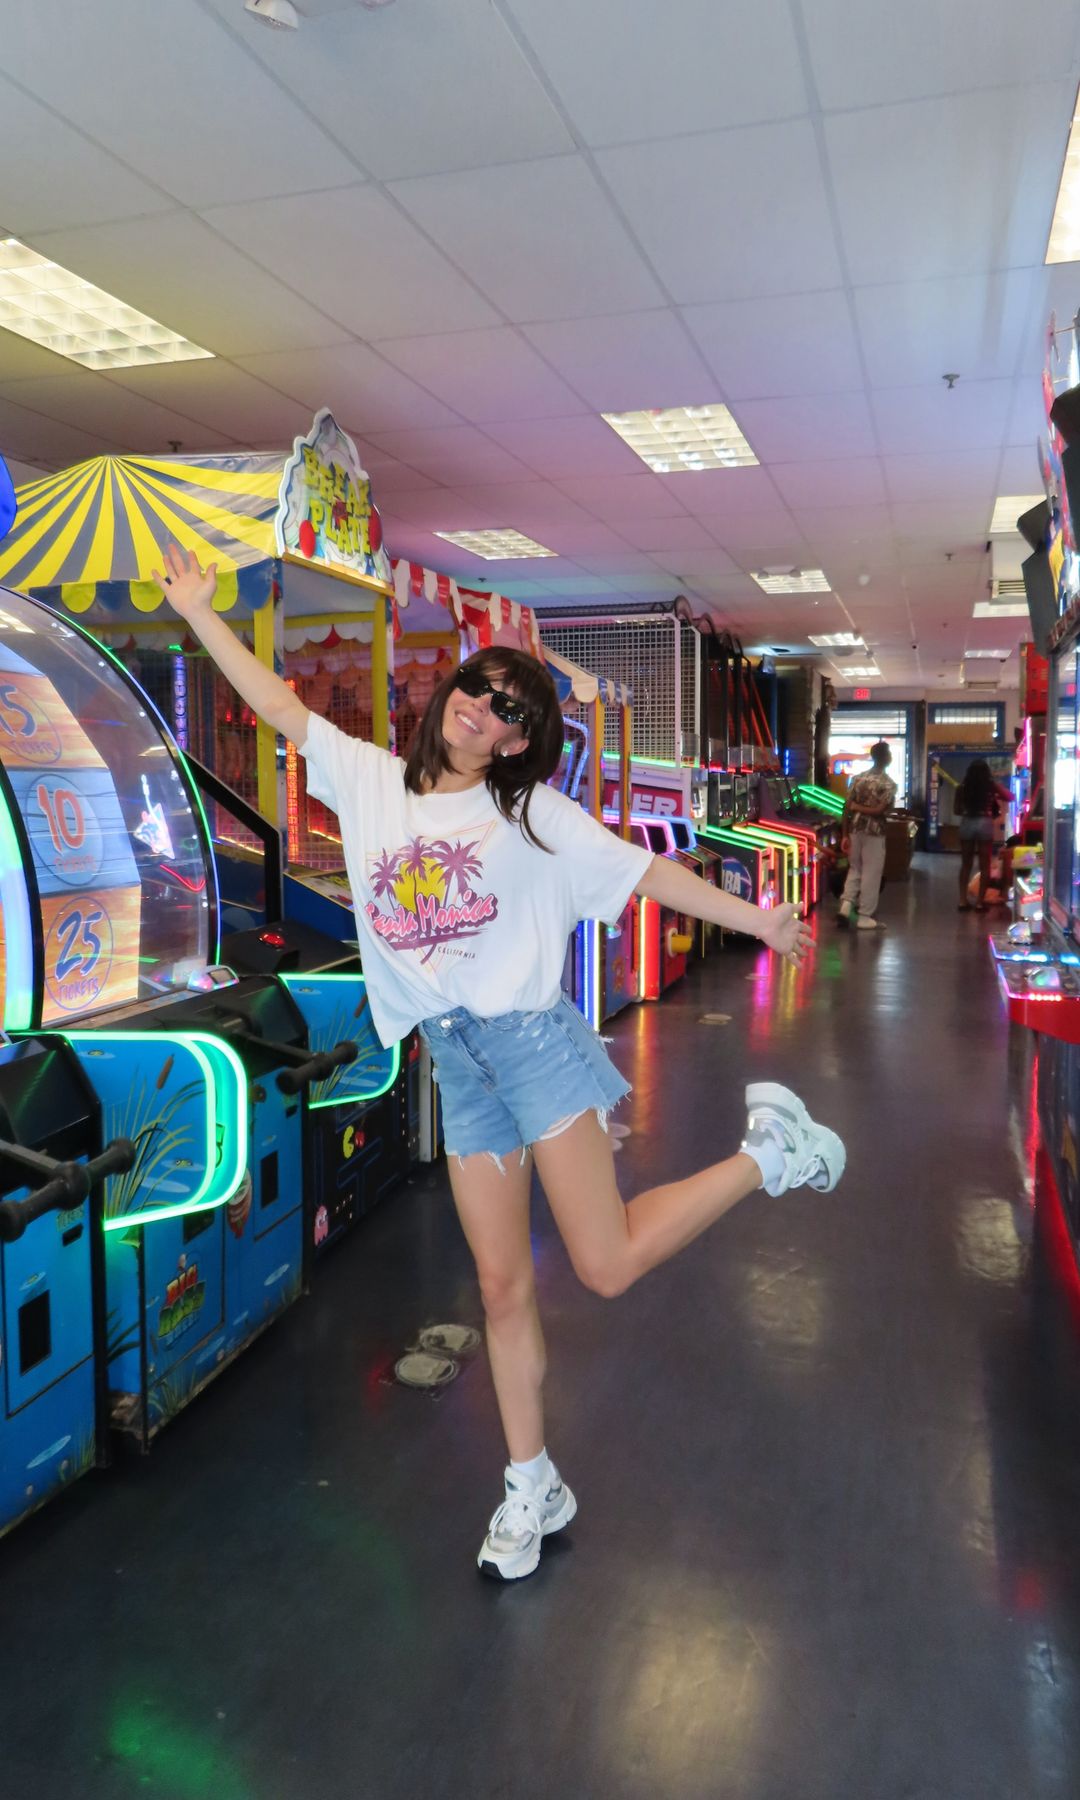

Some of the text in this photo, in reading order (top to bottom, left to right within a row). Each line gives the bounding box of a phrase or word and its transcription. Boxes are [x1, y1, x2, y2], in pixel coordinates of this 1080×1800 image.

[309, 497, 372, 556] PLATE
[37, 784, 85, 855] 10
[415, 888, 496, 933] Monica
[55, 909, 103, 982] 25
[58, 977, 100, 1000] TICKETS
